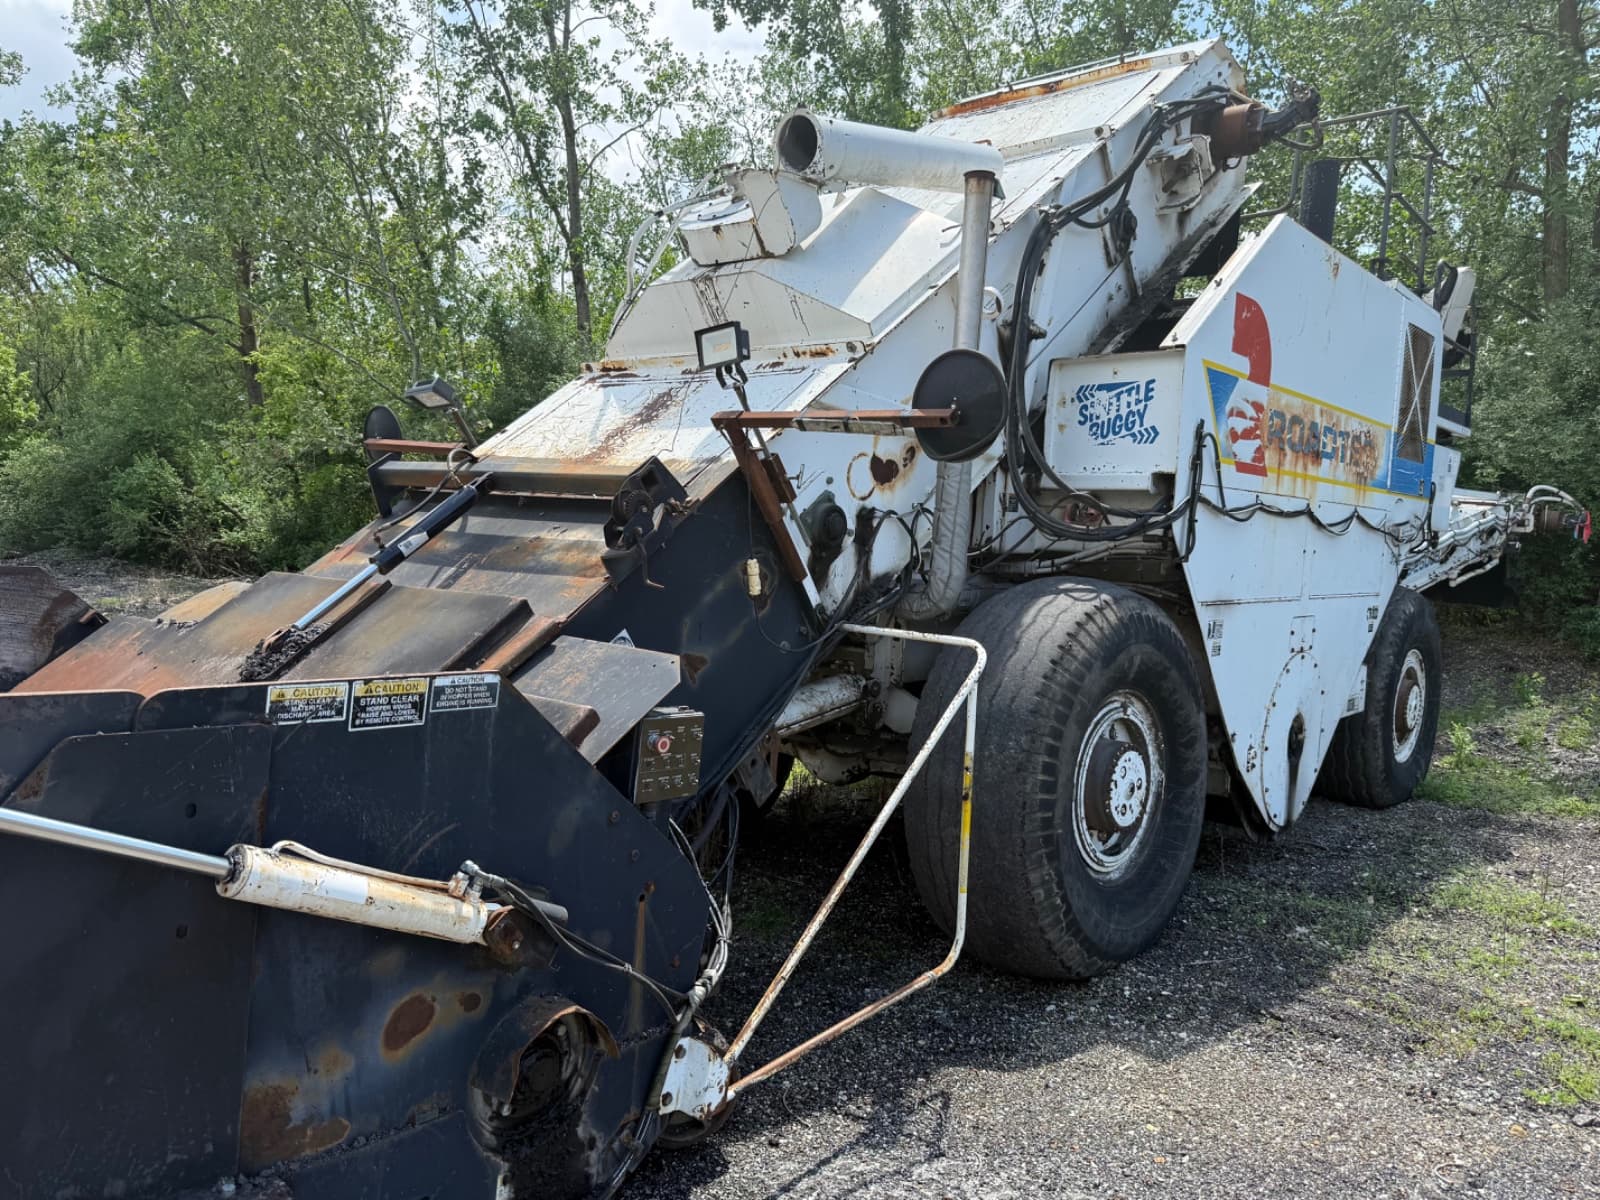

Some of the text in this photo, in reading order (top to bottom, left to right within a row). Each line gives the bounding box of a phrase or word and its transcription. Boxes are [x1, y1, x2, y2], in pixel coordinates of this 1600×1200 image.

[1078, 378, 1156, 426] SHTTLE
[1088, 404, 1148, 440] BUGGY
[1267, 408, 1373, 468] ROADT
[293, 687, 338, 697] CAUTION
[375, 682, 419, 694] CAUTION
[360, 695, 420, 706] STAND CLEAR
